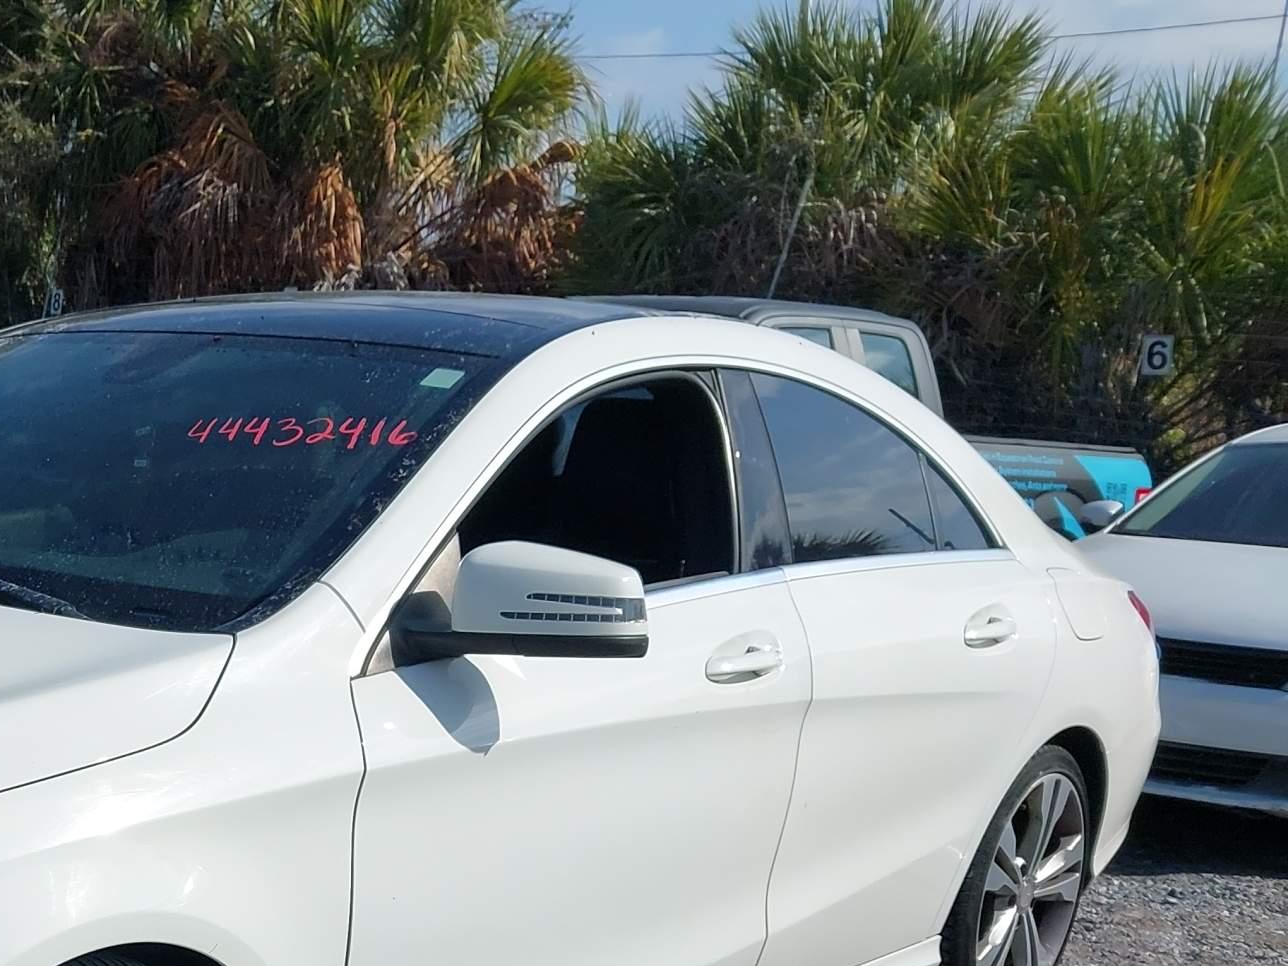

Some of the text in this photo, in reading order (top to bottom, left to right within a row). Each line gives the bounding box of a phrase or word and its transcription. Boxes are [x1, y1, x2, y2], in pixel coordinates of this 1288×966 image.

[52, 292, 61, 311] 8
[1147, 340, 1168, 370] 6
[187, 416, 418, 449] 44432416
